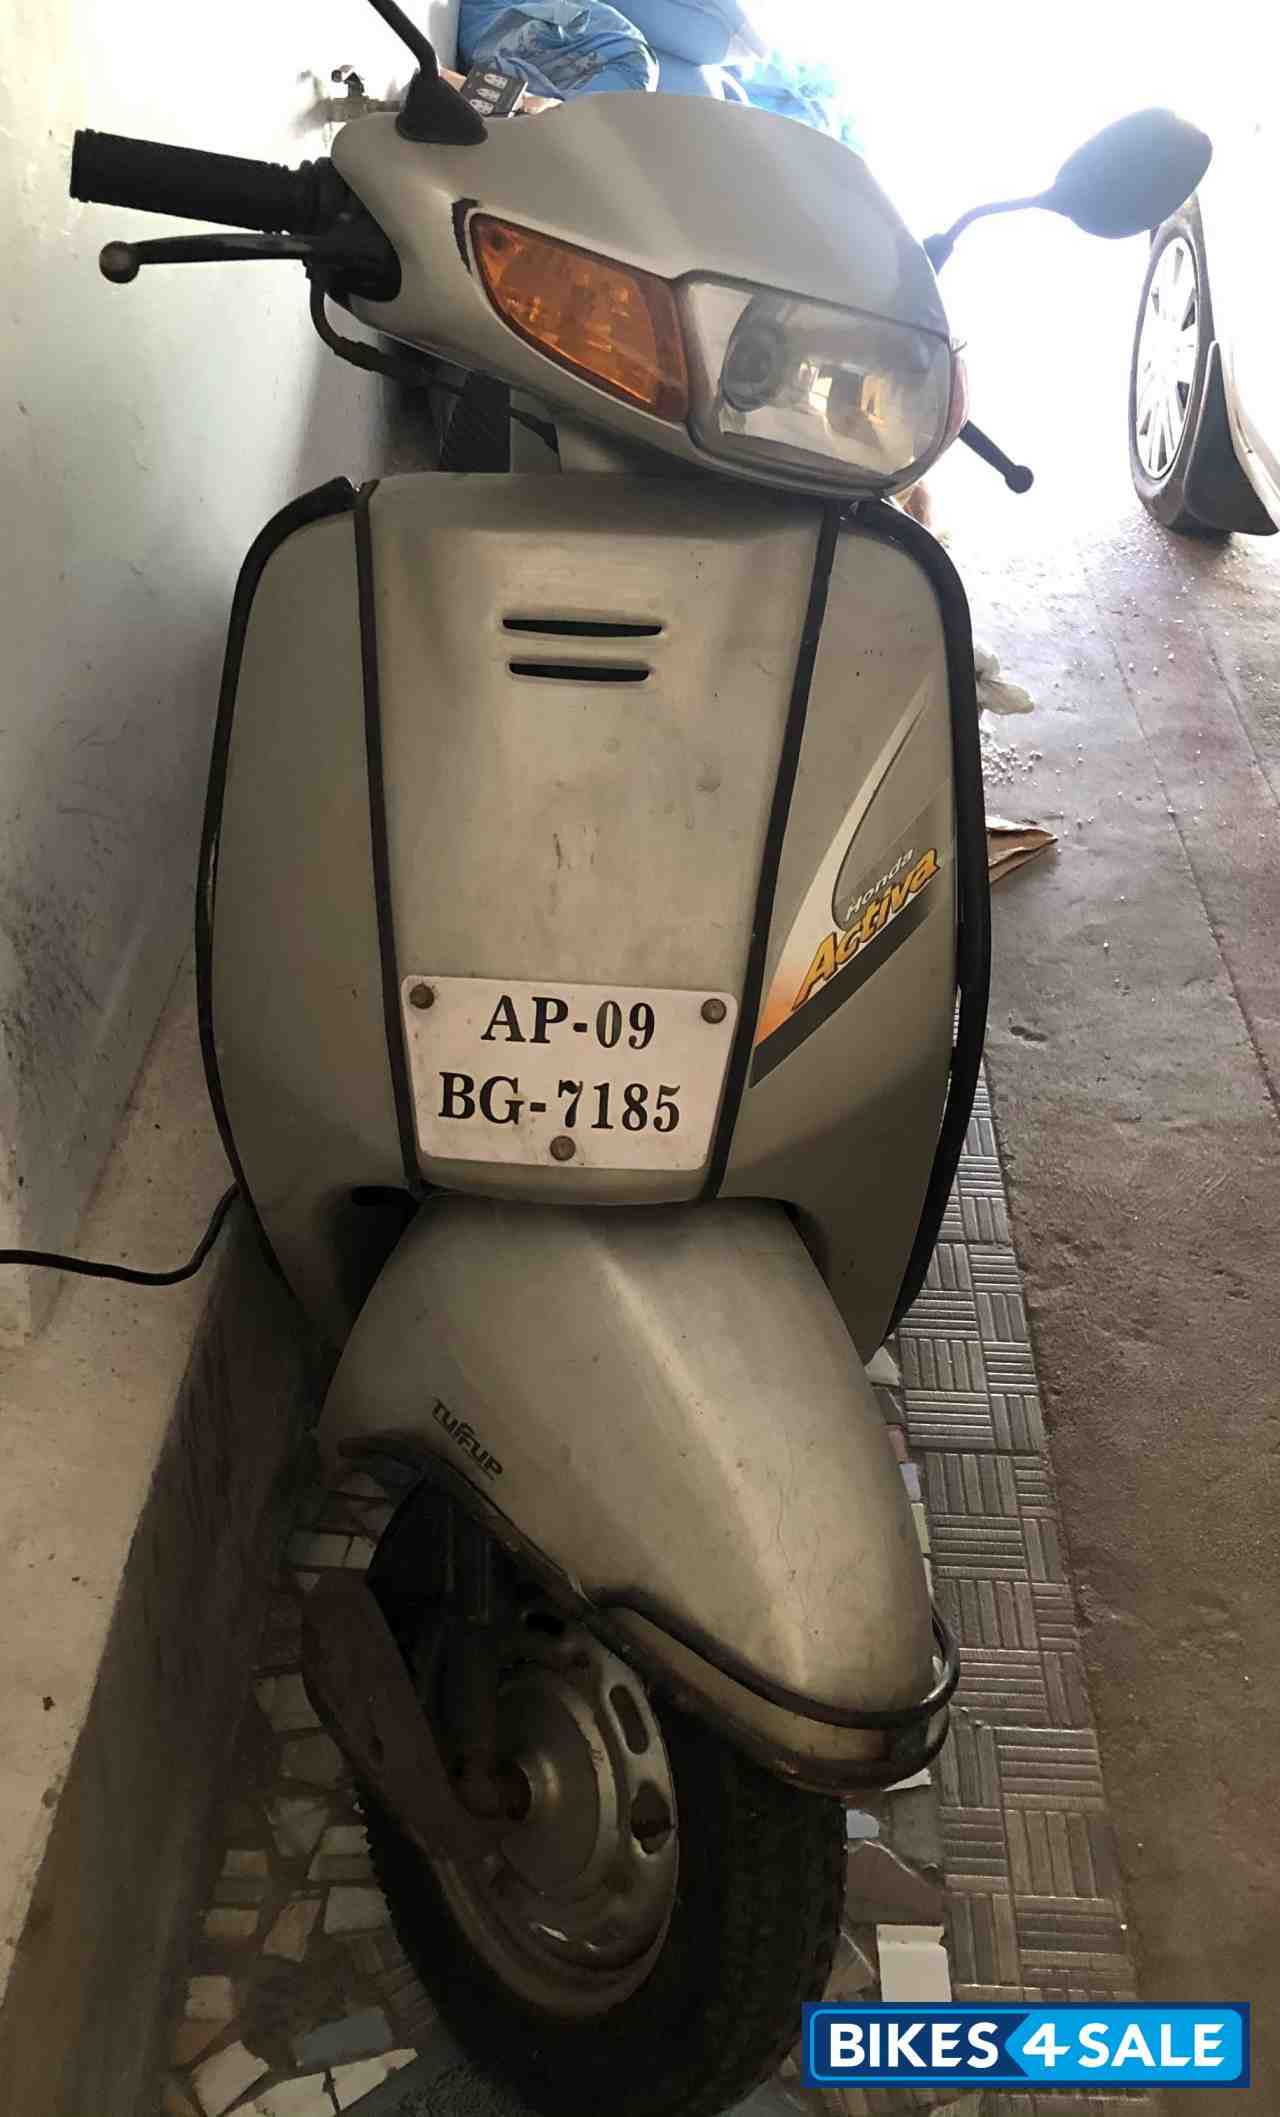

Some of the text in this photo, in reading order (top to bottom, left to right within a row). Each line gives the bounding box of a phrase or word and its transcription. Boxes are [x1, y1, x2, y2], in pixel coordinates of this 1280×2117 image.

[792, 848, 940, 1010] Activa
[480, 994, 656, 1050] AP-09
[438, 1072, 681, 1133] BG-7185
